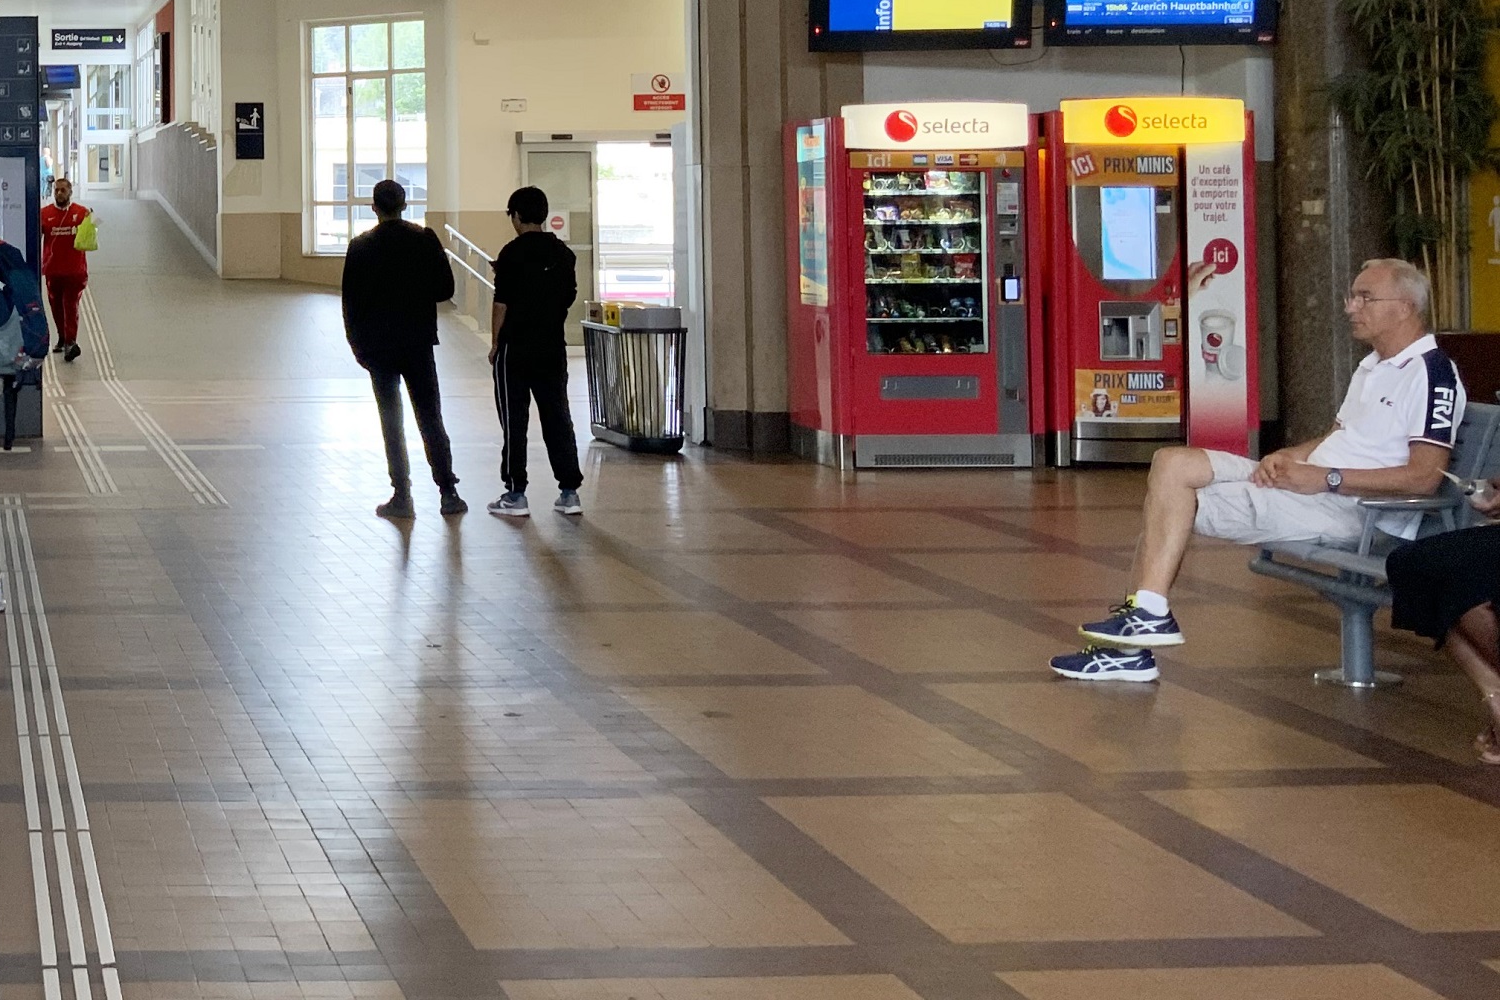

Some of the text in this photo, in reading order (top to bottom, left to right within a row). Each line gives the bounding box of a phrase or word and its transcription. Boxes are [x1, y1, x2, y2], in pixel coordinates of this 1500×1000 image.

[1131, 1, 1241, 12] Zuerich Hauptbahnhof
[54, 33, 79, 41] Sortie
[922, 118, 989, 134] selecta
[1141, 112, 1207, 130] selecta
[866, 153, 892, 168] Ici!
[1071, 154, 1096, 178] ICI
[1103, 156, 1174, 174] PRIX MINIS
[1199, 164, 1231, 174] Un café
[1191, 176, 1239, 187] d'exception
[1192, 188, 1238, 200] à emporter
[1194, 201, 1237, 212] pour votre
[1203, 213, 1228, 224] trajet.
[1213, 247, 1229, 263] ici
[1094, 373, 1164, 389] PRIX MINIS
[1121, 394, 1137, 404] MAX
[1430, 386, 1454, 429] FRA
